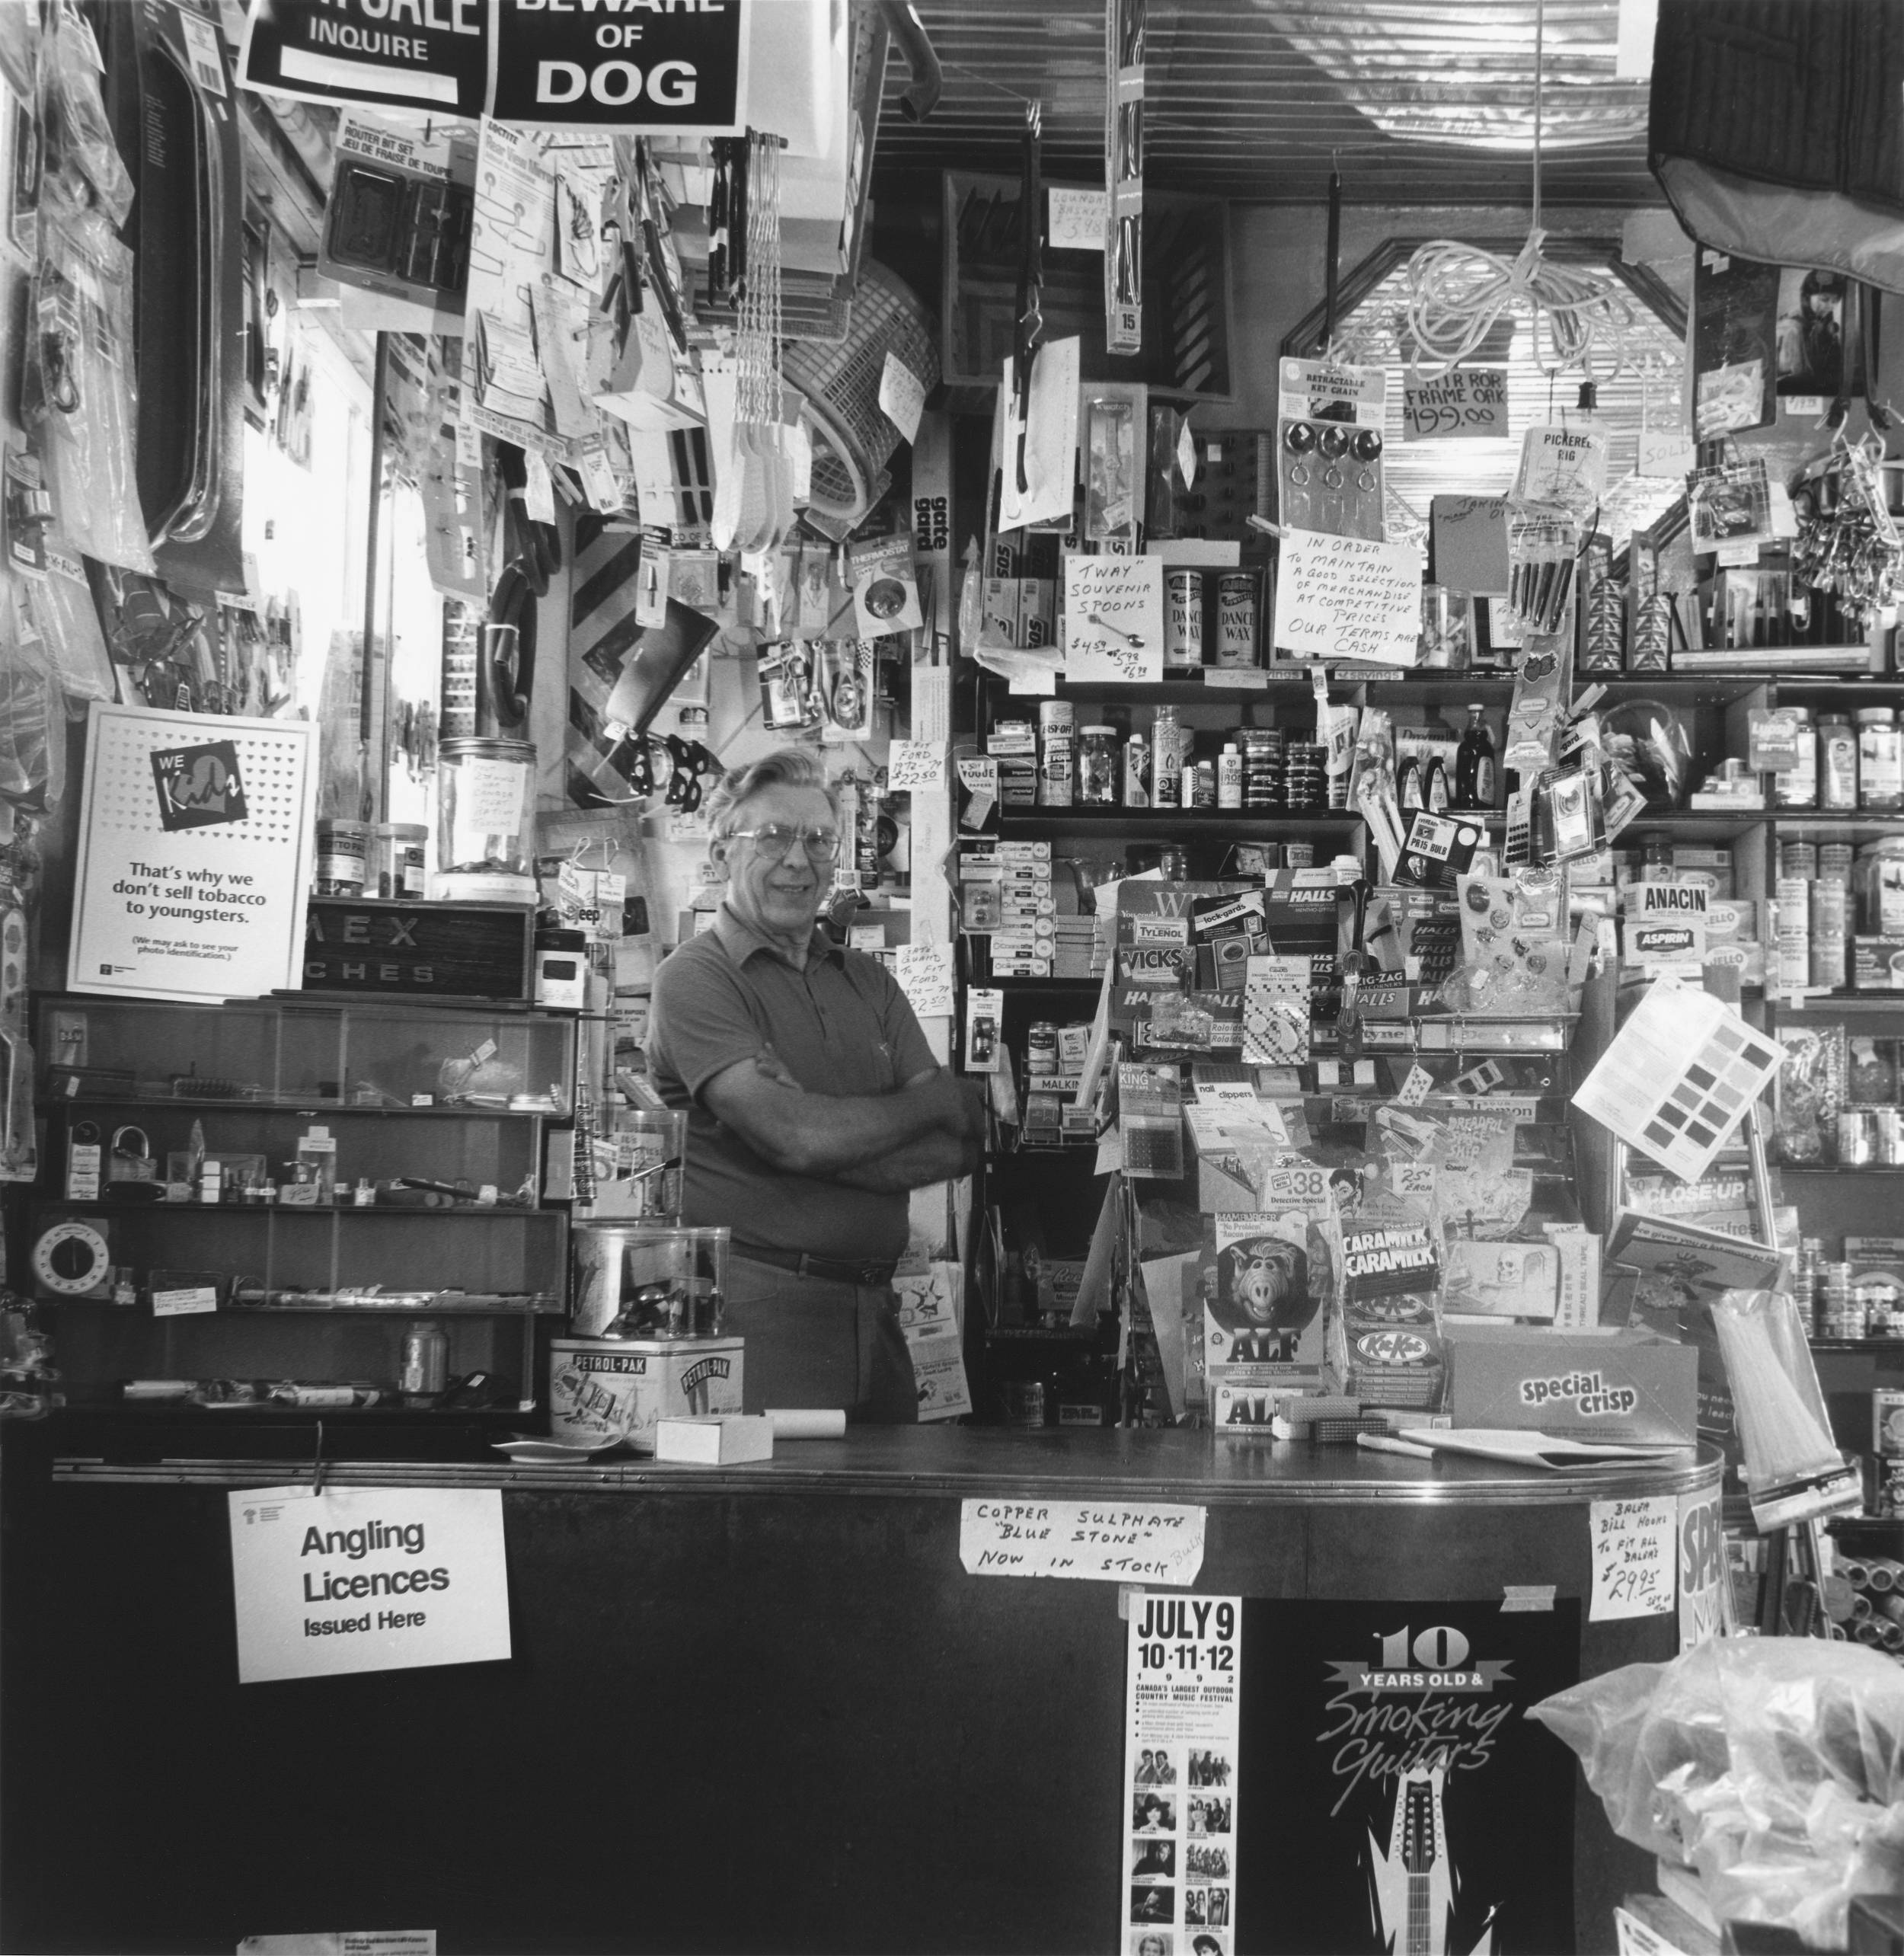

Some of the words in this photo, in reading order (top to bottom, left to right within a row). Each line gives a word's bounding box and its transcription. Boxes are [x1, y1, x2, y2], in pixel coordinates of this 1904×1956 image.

[310, 16, 428, 61] INQUIRE
[595, 24, 644, 48] OF
[535, 59, 698, 107] DOG
[345, 126, 381, 146] ROUTER
[382, 136, 395, 151] BIT
[397, 140, 415, 156] SET
[343, 136, 360, 152] JEU
[360, 143, 374, 155] DE
[374, 146, 407, 165] FRAISE
[408, 156, 422, 169] DE
[423, 161, 454, 178] TOUPIE
[1122, 313, 1136, 330] 15
[1311, 385, 1329, 395] KEY
[1331, 385, 1359, 397] CHAIN
[1405, 389, 1467, 404] FRAME
[1474, 388, 1505, 404] OAK
[1544, 433, 1593, 449] PICKEREL
[1557, 449, 1576, 462] RIG
[1645, 441, 1692, 464] SOLD
[915, 497, 933, 551] gard
[931, 496, 950, 550] gate
[1307, 538, 1325, 548] IN
[1331, 540, 1380, 555] ORDER
[1311, 555, 1392, 573] MAINTAIN
[1293, 567, 1302, 576] A
[1307, 569, 1338, 580] GOOD
[1348, 574, 1417, 589] SELECTION
[1071, 583, 1152, 597] SOUVENIR
[1297, 581, 1310, 590] OF
[1317, 583, 1411, 600] MERCHANDISE
[1078, 599, 1145, 614] SPOONS
[1296, 594, 1315, 603] AT
[1319, 596, 1412, 613] COMPETITIVE
[1222, 611, 1254, 625] DANCE
[1333, 609, 1387, 623] PRICES
[1226, 626, 1251, 641] WAX
[1288, 618, 1327, 635] OUR
[1336, 625, 1390, 641] TERMS
[1394, 634, 1417, 643] ARE
[1334, 638, 1379, 654] CASH
[158, 754, 185, 770] WE
[899, 750, 931, 761] FORD
[1410, 838, 1429, 850] PR15
[1430, 843, 1448, 856] BULB
[129, 862, 182, 880] That's
[187, 868, 223, 887] why
[228, 874, 254, 886] we
[113, 880, 160, 897] don't
[165, 886, 193, 900] sell
[198, 888, 267, 906] tobacco
[1289, 890, 1336, 903] HALLS
[1645, 887, 1706, 912] ANACIN
[126, 901, 145, 914] to
[148, 905, 249, 923] youngsters.
[1203, 903, 1247, 924] lock-gards
[1140, 926, 1184, 938] TYLENOL
[1642, 933, 1689, 944] ASPIRIN
[137, 946, 165, 956] photo
[152, 938, 171, 948] may
[1414, 945, 1455, 954] HALLS
[1122, 949, 1184, 970] VICKS
[909, 976, 938, 986] FORD
[1212, 1023, 1243, 1032] Rolaids
[1212, 1034, 1243, 1044] Rolaids
[1120, 1063, 1132, 1072] 48
[1120, 1072, 1148, 1085] KING
[1219, 1091, 1253, 1100] clippers
[1648, 1181, 1746, 1202] CLOSE-UP
[1302, 1197, 1326, 1205] Special
[1343, 1229, 1426, 1255] CARAMILK
[1346, 1247, 1436, 1277] CARAMILK
[1226, 1328, 1302, 1363] ALF
[576, 1357, 645, 1373] PETROL-PAK
[682, 1359, 729, 1392] PETROL-PAK
[1522, 1374, 1600, 1403] special
[1579, 1389, 1635, 1414] crisp
[977, 1504, 1048, 1521] COPPER
[1078, 1510, 1185, 1529] SULPHATE
[1637, 1516, 1666, 1528] HOOKS
[300, 1520, 424, 1560] Angling
[1641, 1537, 1657, 1548] ALL
[978, 1549, 1024, 1568] NOW
[1050, 1557, 1074, 1568] IN
[1101, 1557, 1169, 1577] STOCK
[303, 1567, 450, 1603] Licences
[305, 1612, 371, 1637] Issued
[378, 1609, 426, 1630] Here
[1138, 1600, 1212, 1640] JULY
[1216, 1601, 1235, 1641] 9
[1372, 1625, 1470, 1670] 10
[1360, 1673, 1425, 1686] YEARS
[1428, 1673, 1467, 1686] OLD
[1471, 1673, 1484, 1686] &
[1136, 1684, 1168, 1692] CANADA'S
[1171, 1685, 1200, 1693] LARGEST
[1203, 1686, 1234, 1695] OUTDOOR
[1136, 1692, 1168, 1701] COUNTRY
[1200, 1694, 1233, 1703] FESTIVAL
[1316, 1689, 1513, 1747] Smoking
[1330, 1734, 1497, 1817] Guitars
